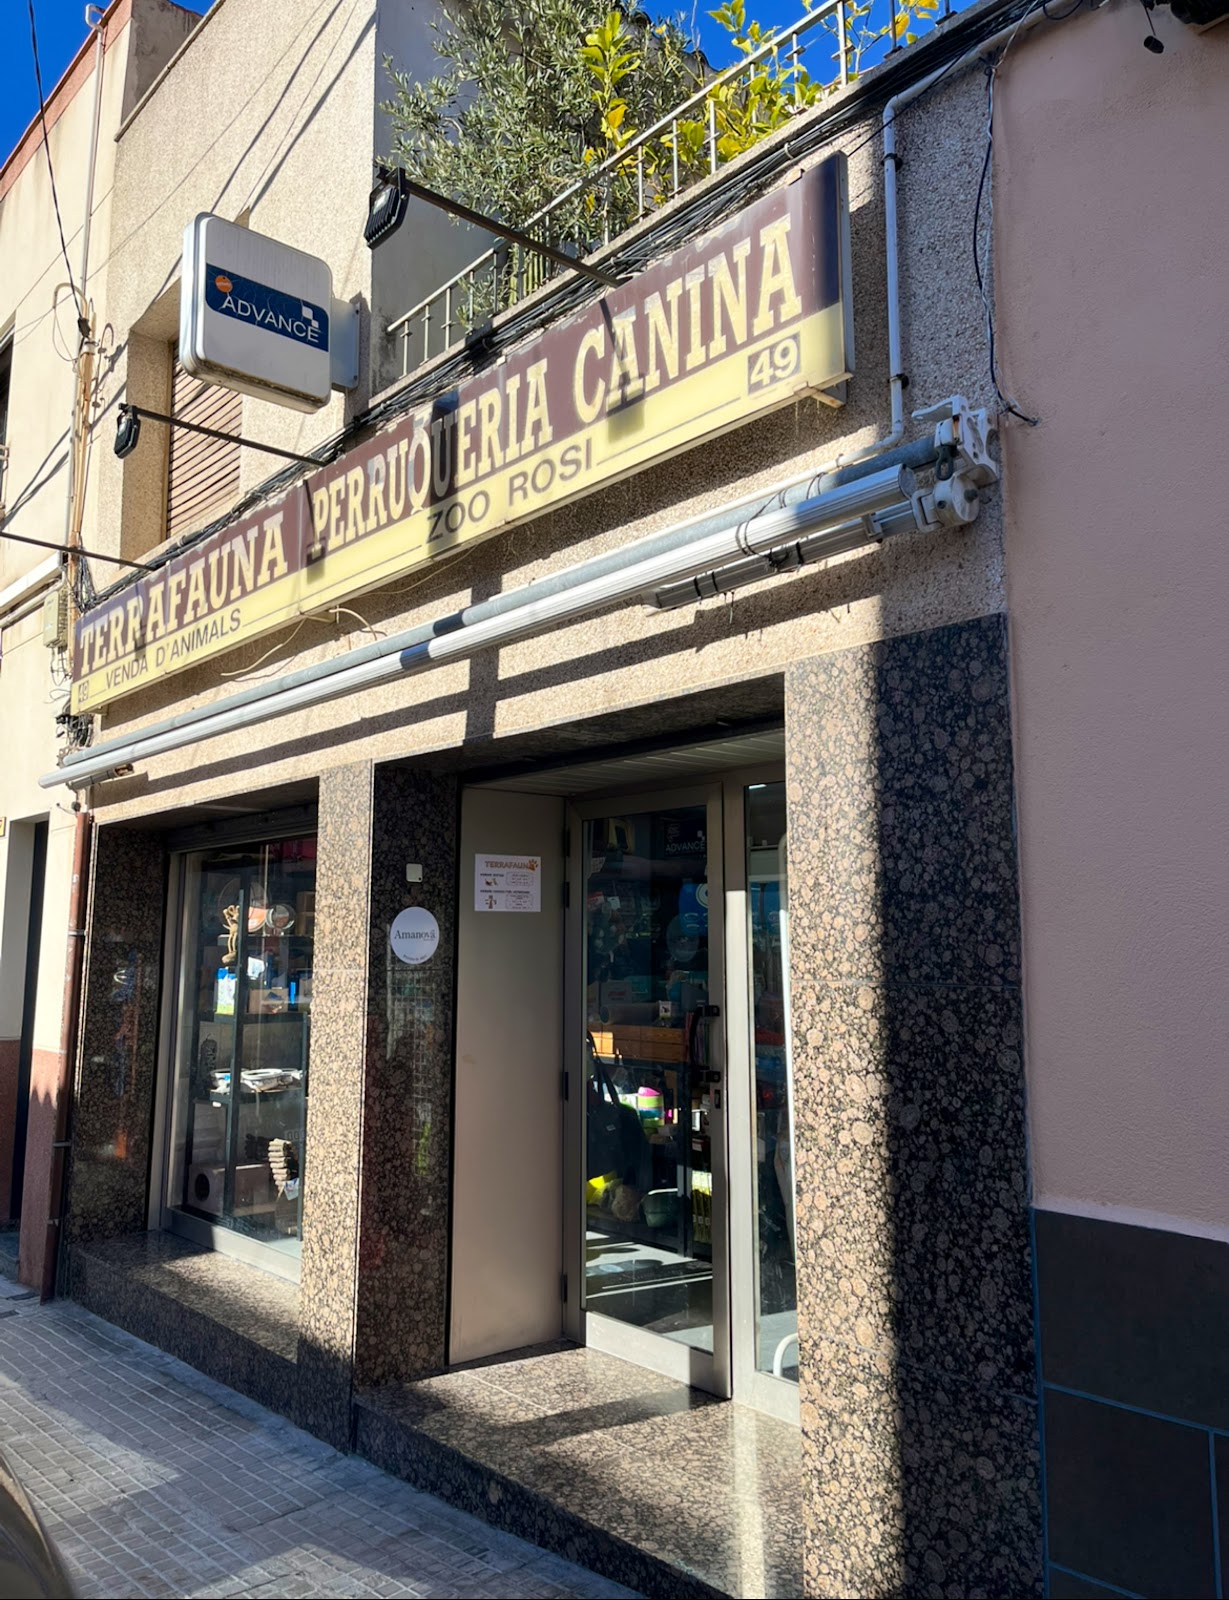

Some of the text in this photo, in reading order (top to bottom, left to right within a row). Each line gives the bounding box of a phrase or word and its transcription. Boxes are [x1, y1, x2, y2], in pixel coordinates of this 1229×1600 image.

[222, 296, 319, 343] ADVANCE
[751, 338, 798, 386] 49
[80, 213, 801, 677] TERRAFAUNA PERRUQUERIA CANINA
[427, 438, 592, 541] ZOO ROSI
[106, 608, 240, 689] VENDA D'ANIMALS
[485, 860, 532, 869] TERRAFAUN
[665, 841, 705, 852] ADVANCE
